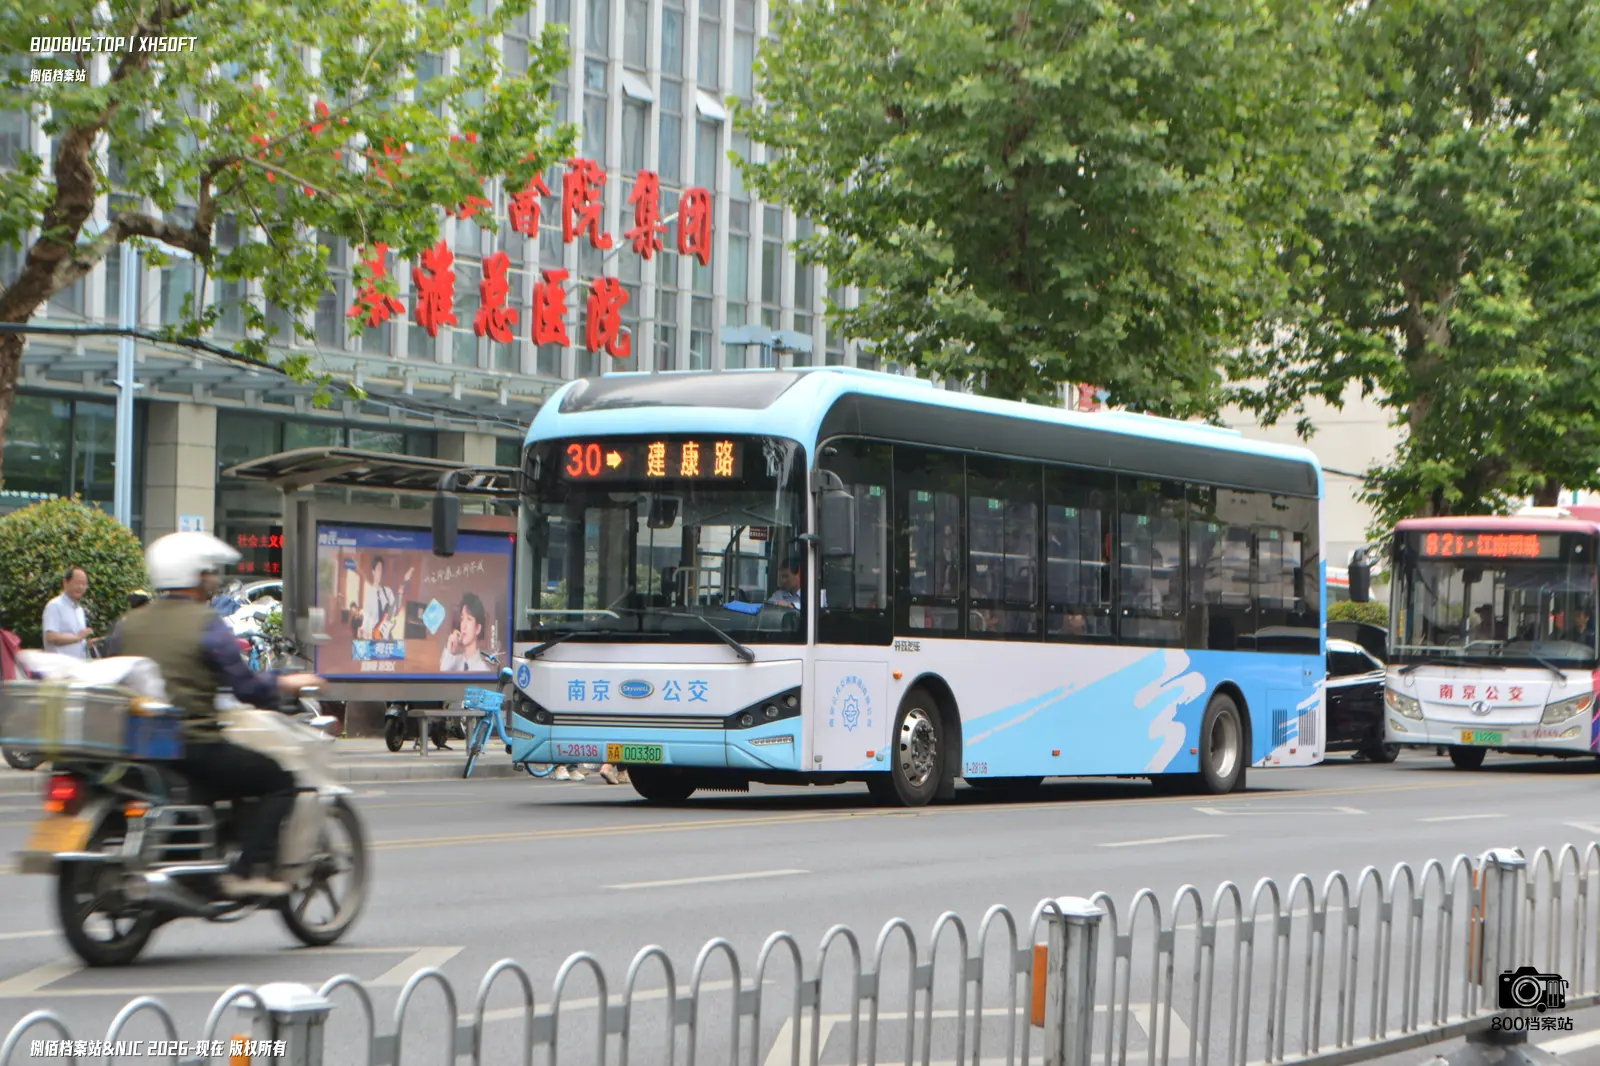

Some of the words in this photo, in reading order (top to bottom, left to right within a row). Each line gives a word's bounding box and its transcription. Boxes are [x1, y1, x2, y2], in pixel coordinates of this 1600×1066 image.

[566, 443, 601, 477] 30
[647, 440, 734, 477] 建康路
[568, 680, 611, 701] 南京
[662, 680, 709, 702] 公交
[1440, 684, 1524, 701] 南京公交
[557, 743, 598, 758] 1-28136
[966, 762, 988, 774] 1-28136
